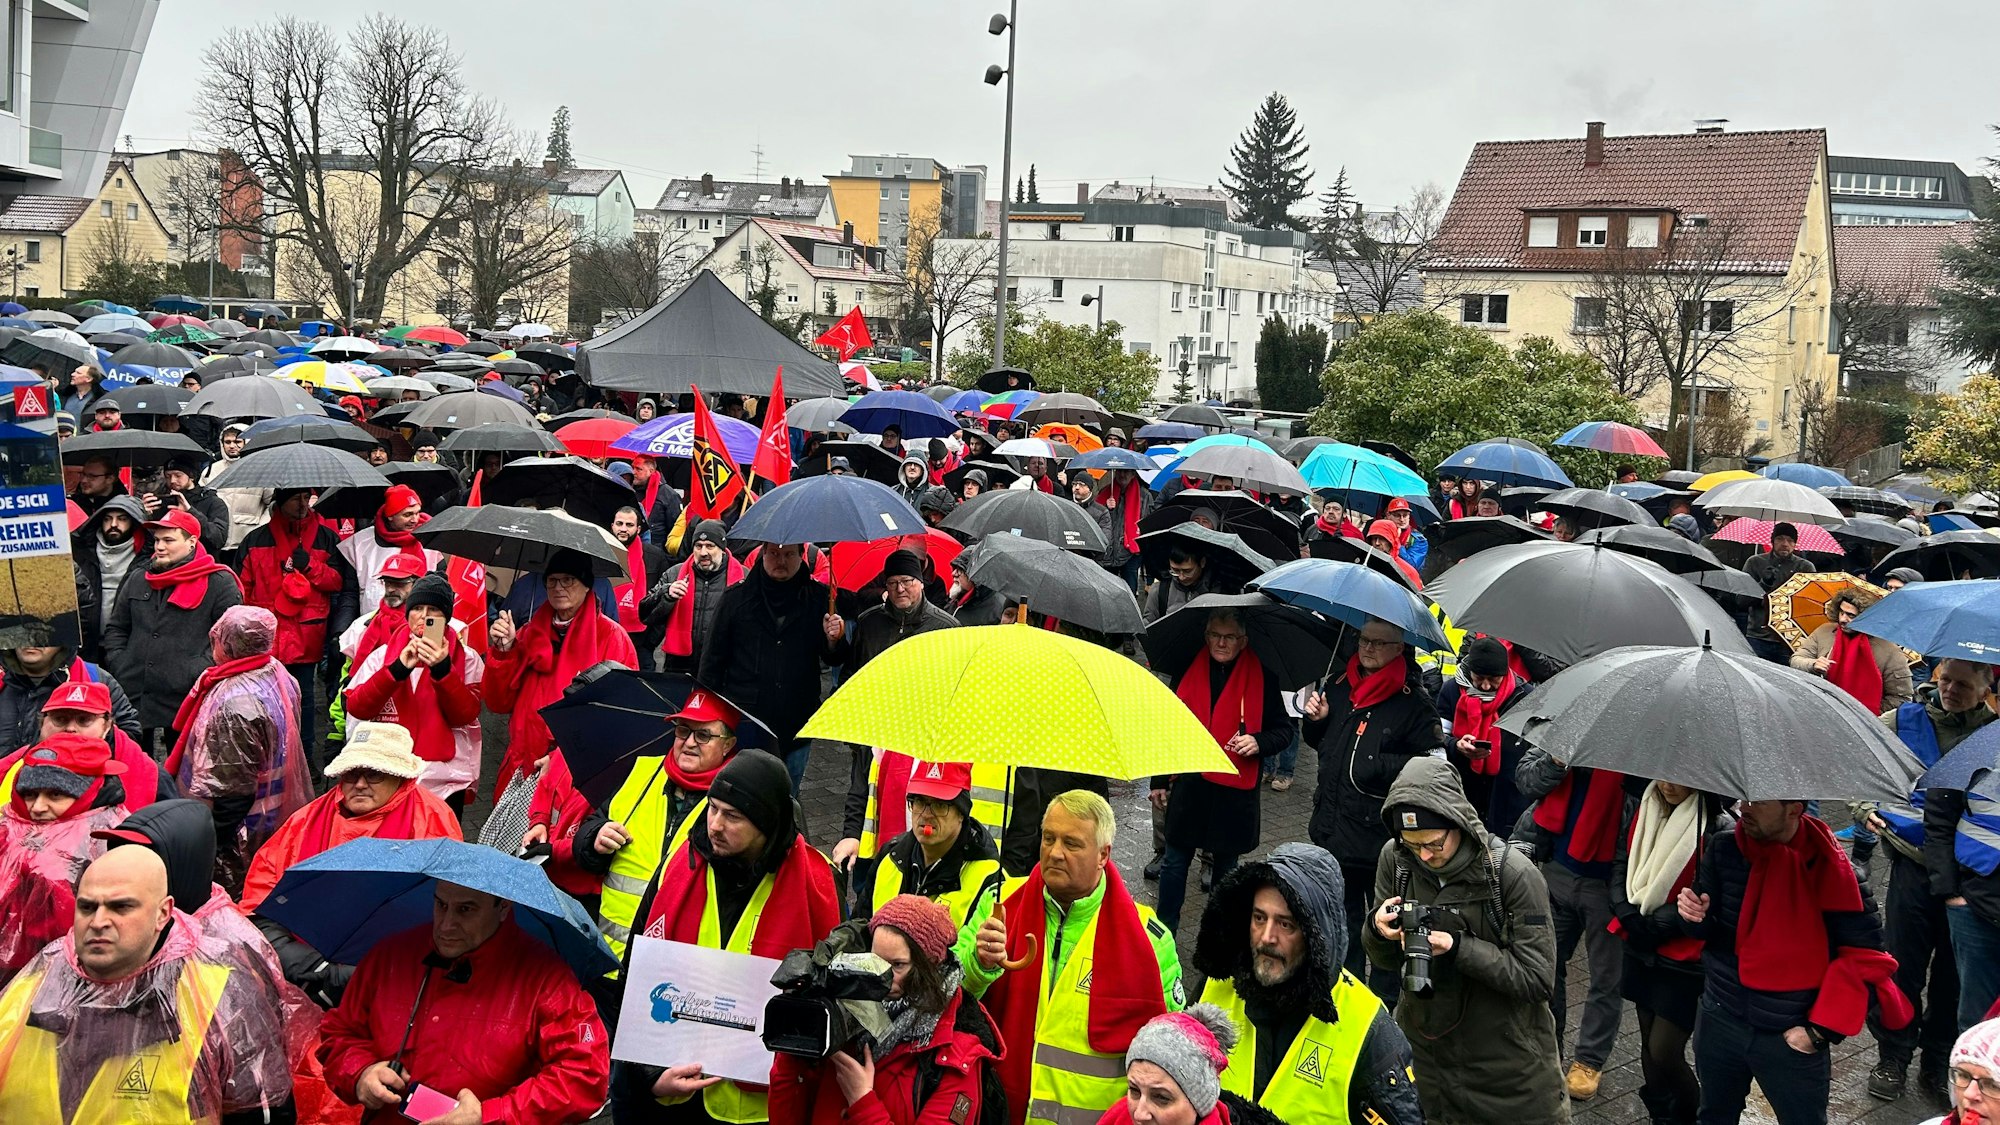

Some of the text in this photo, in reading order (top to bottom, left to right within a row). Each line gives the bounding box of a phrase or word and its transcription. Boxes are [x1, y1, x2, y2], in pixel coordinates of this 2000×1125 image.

[647, 442, 665, 453] IG
[17, 493, 49, 509] SICH
[1, 540, 59, 553] ZUSAMMEN.
